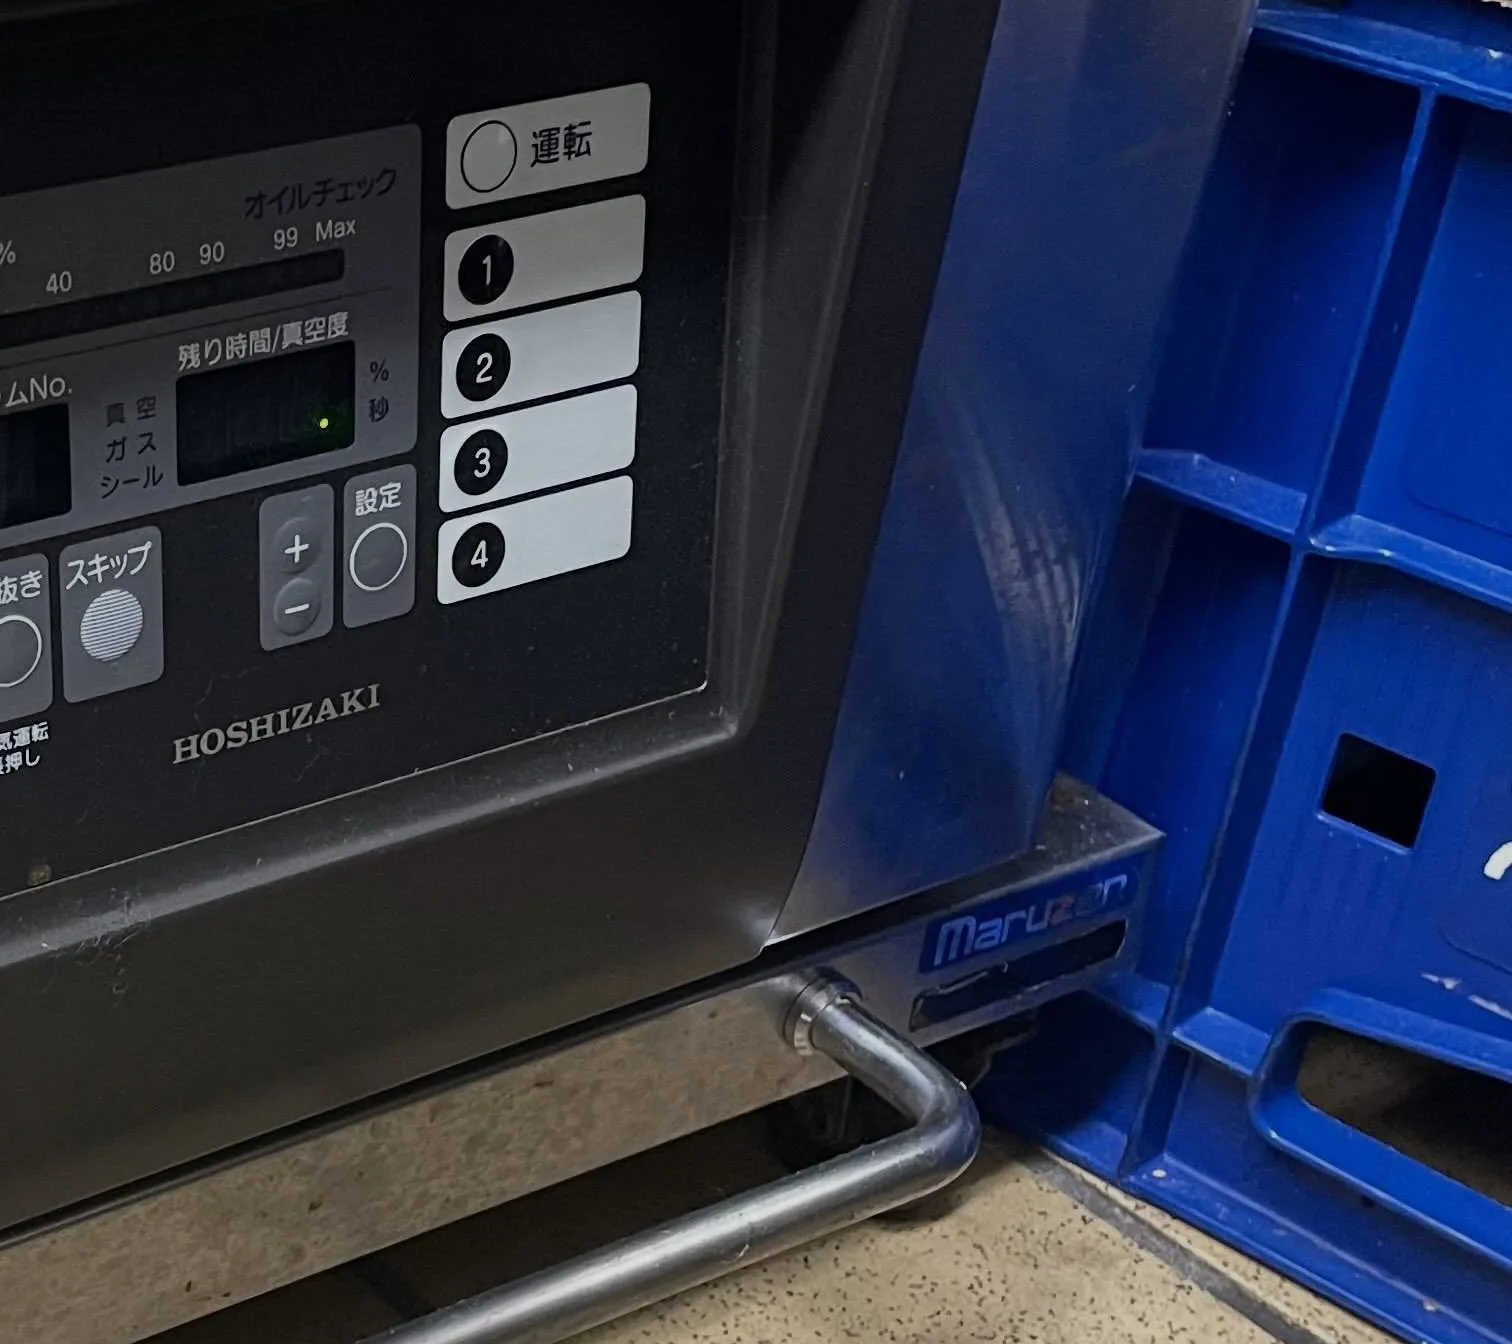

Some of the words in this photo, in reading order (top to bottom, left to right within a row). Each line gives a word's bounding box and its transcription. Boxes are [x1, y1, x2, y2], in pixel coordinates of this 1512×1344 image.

[530, 121, 593, 169] 運転
[243, 167, 398, 220] オイルチェック
[46, 271, 73, 296] 40
[149, 250, 176, 274] 80
[199, 241, 225, 266] 90
[273, 228, 299, 251] 99
[315, 217, 357, 242] Max
[481, 255, 493, 286] 1
[178, 310, 350, 371] 残り時間/真空度
[369, 359, 389, 383] %
[475, 352, 493, 385] 2
[368, 398, 389, 423] 秒
[101, 462, 164, 499] シール
[474, 448, 492, 479] 3
[355, 480, 402, 516] 設定
[65, 541, 153, 591] スキップ
[470, 540, 489, 570] 4
[172, 683, 381, 766] HOSHIZAKI
[933, 874, 1128, 968] Maruzn
